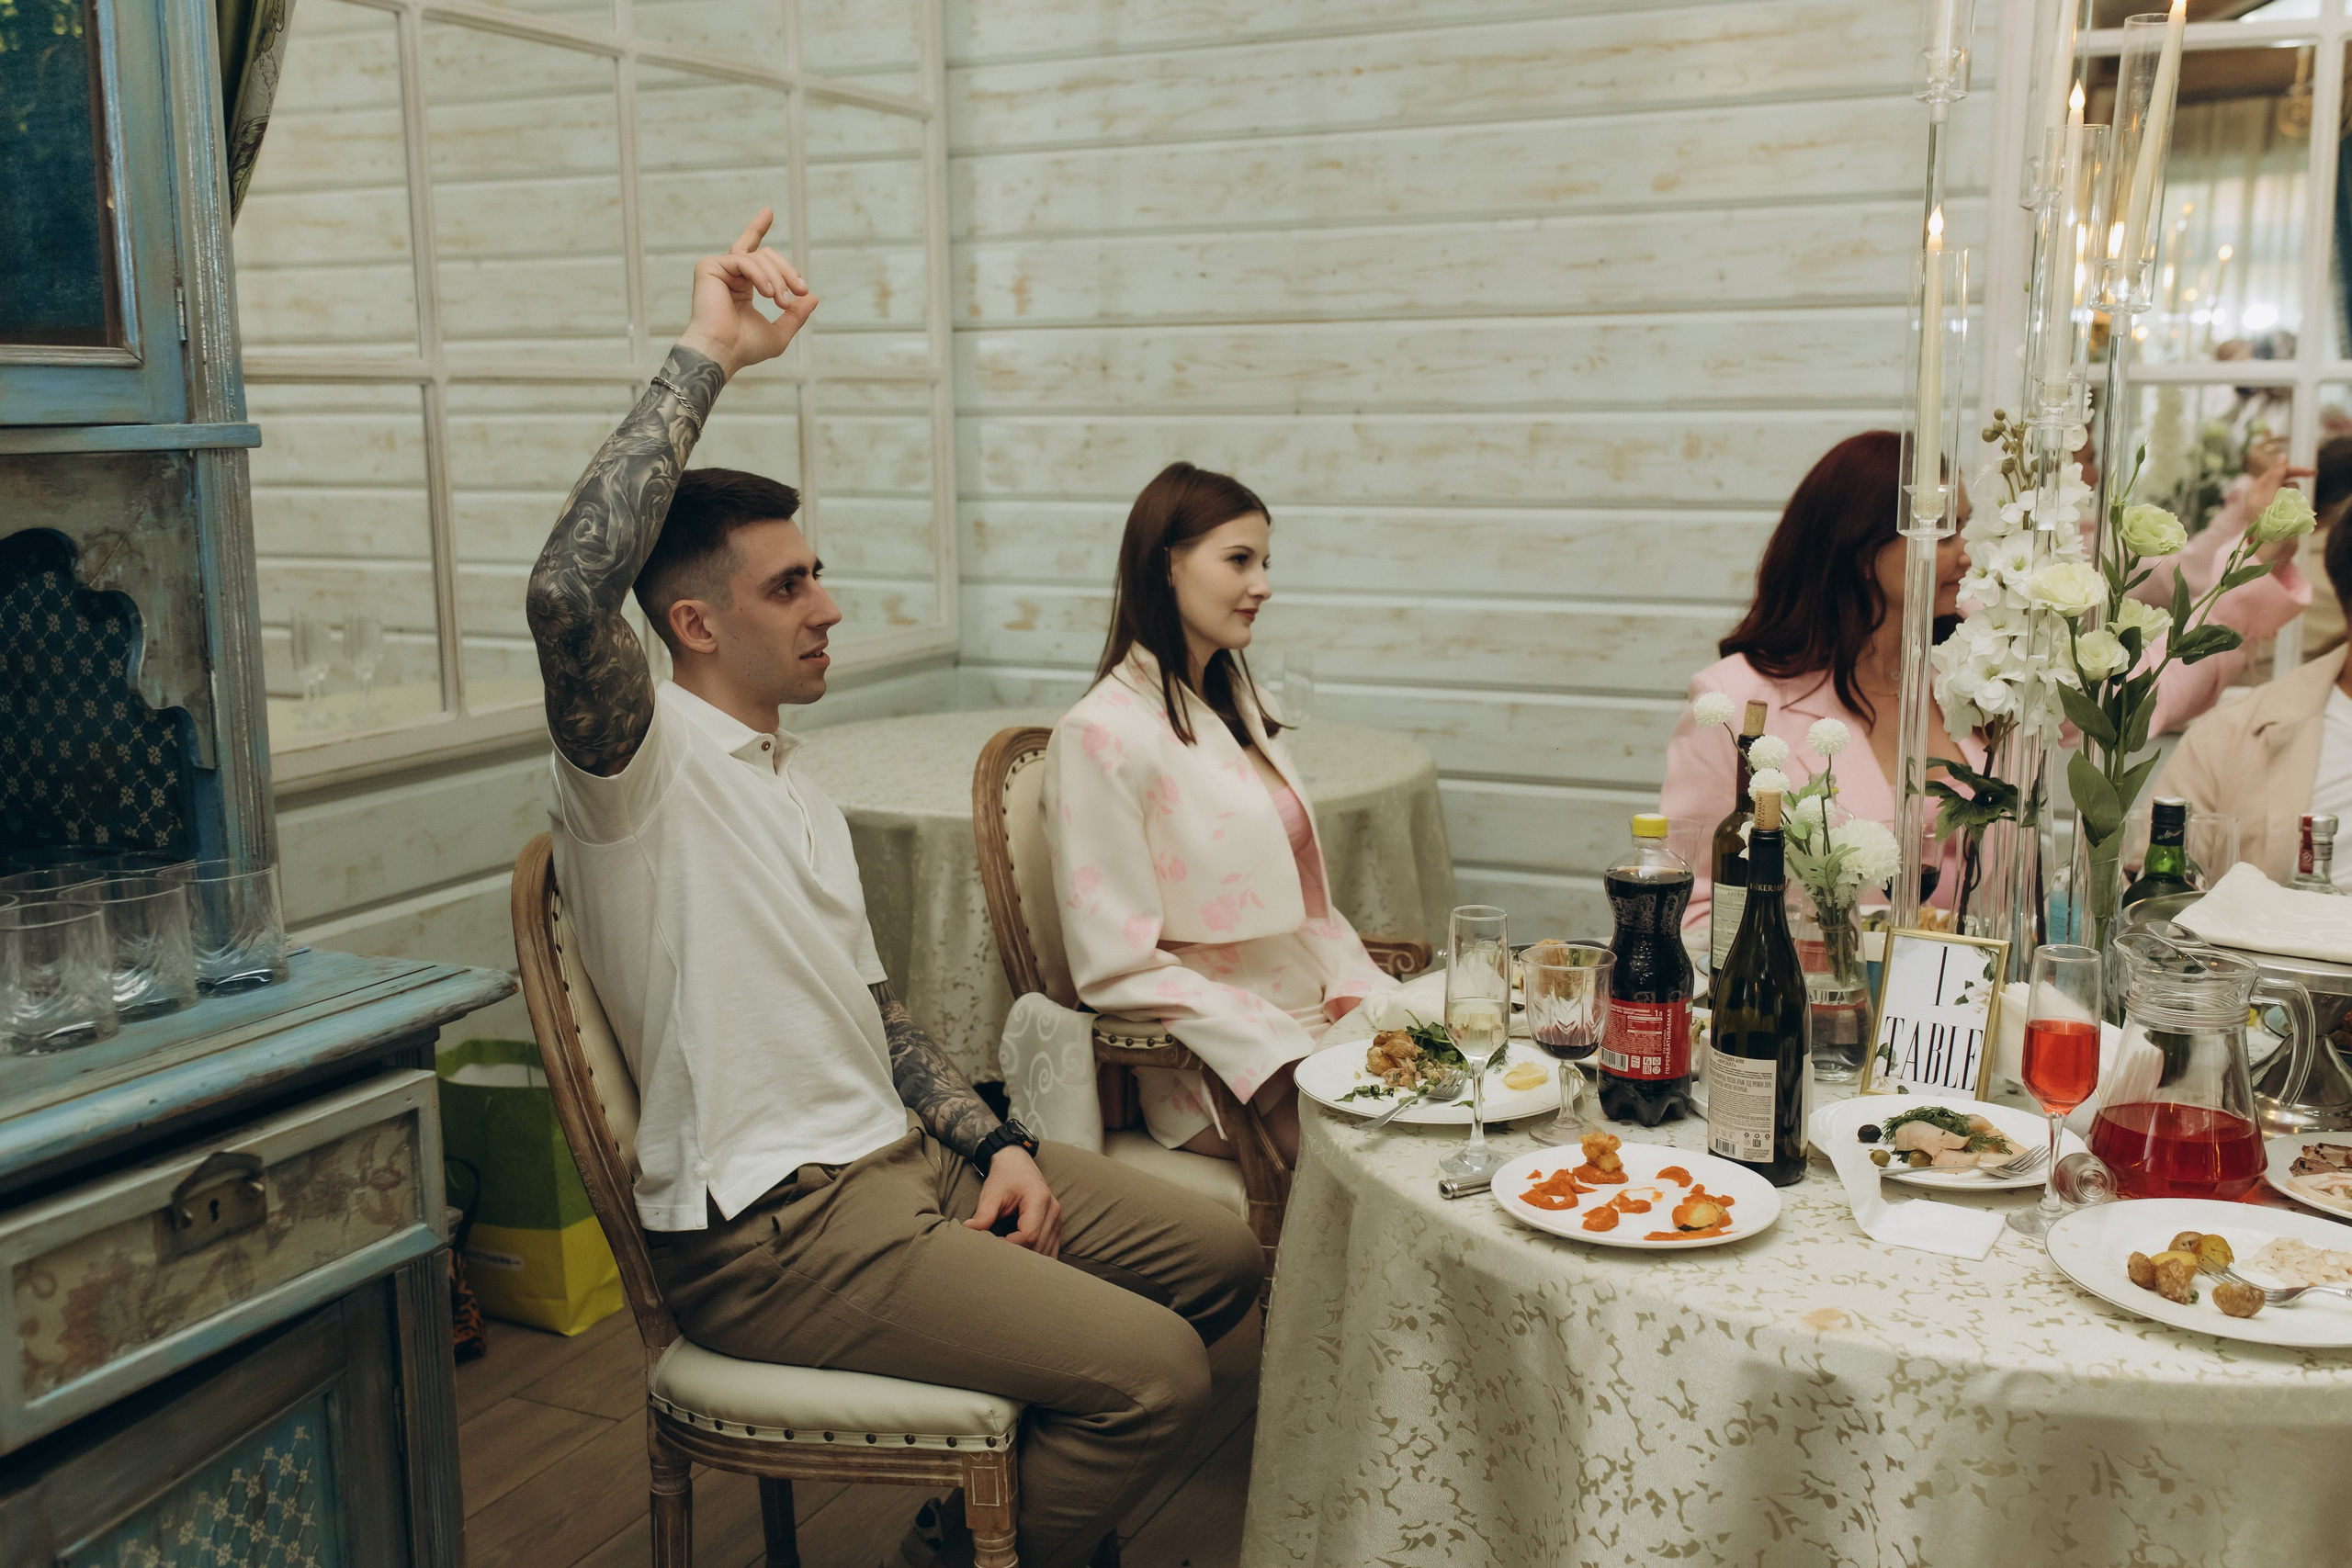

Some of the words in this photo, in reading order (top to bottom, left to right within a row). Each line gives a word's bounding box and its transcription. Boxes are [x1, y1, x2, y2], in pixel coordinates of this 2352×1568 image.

[1749, 882, 1785, 892] INKERMA
[1665, 1009, 1673, 1075] ПЕРЕРАБАТЫВАЕМАЯ
[1883, 1016, 1984, 1091] TABLE
